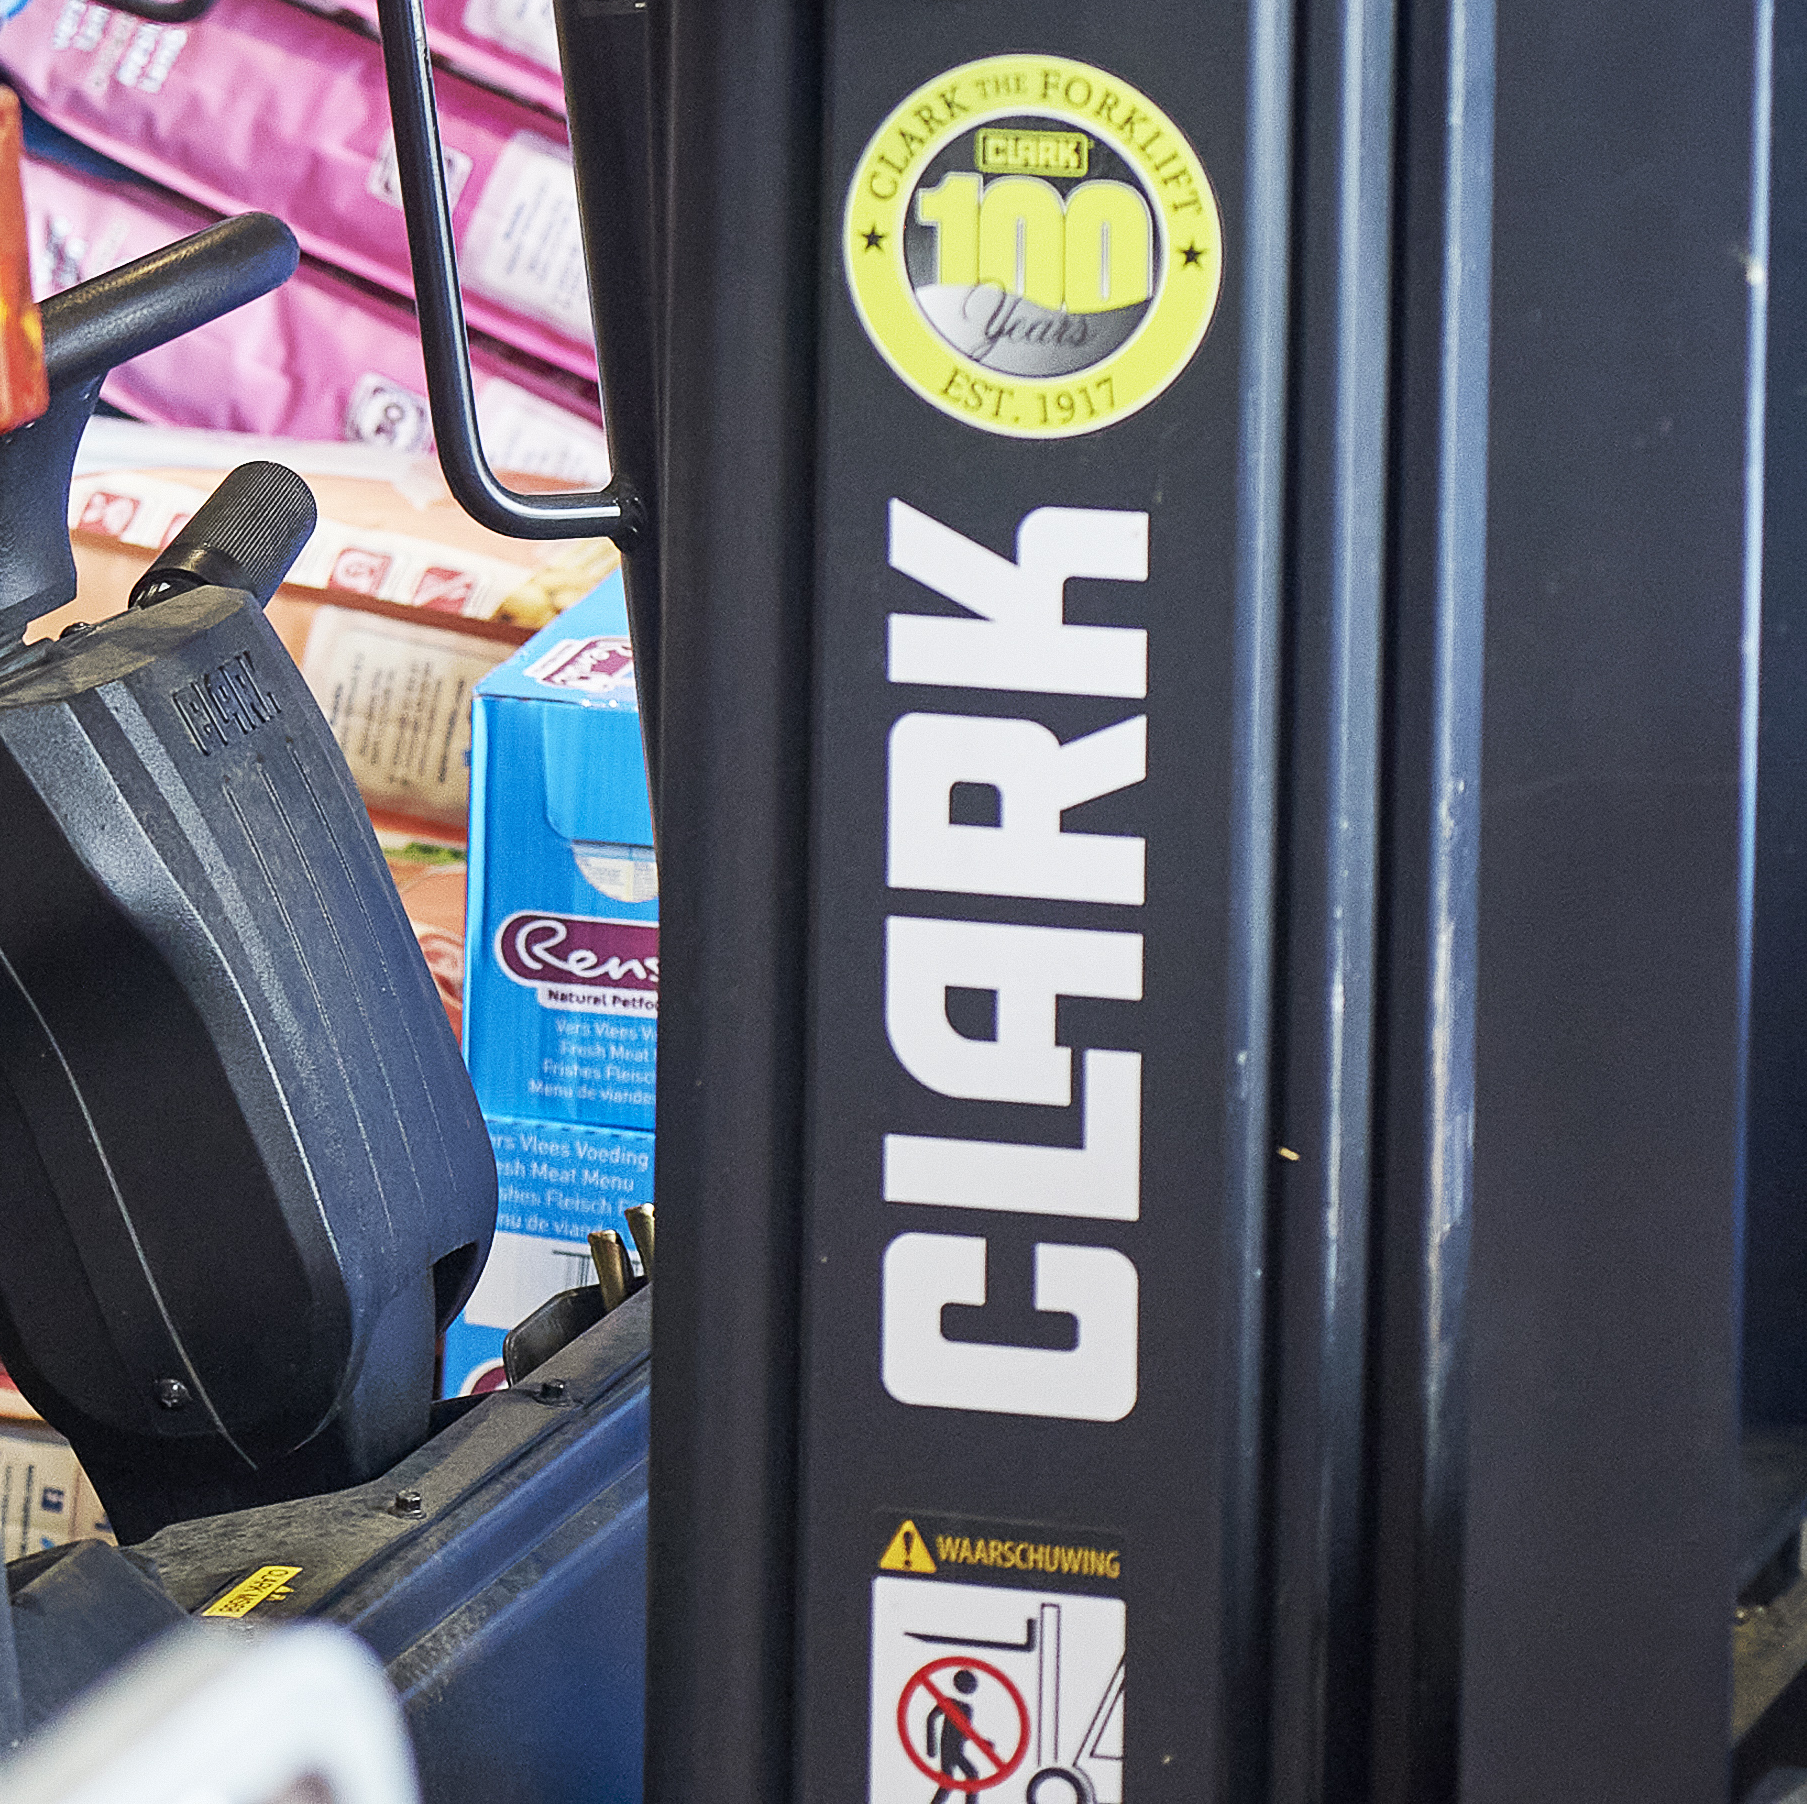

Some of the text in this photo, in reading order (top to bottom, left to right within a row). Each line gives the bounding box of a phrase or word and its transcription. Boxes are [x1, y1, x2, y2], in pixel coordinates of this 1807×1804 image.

[868, 68, 1203, 216] CLARK THE FORKLIFT
[984, 135, 1084, 169] CLARK
[915, 170, 1155, 314] 100
[962, 276, 1093, 363] Years
[941, 366, 1117, 425] EST. 1917
[880, 497, 1150, 1423] CLARK
[546, 988, 608, 1007] Natural
[641, 1025, 656, 1041] V
[490, 1134, 650, 1173] rs Vlees Voeding
[530, 1160, 577, 1185] Meat
[583, 1169, 635, 1193] Menu
[935, 1533, 1122, 1580] WAARSCHUWING
